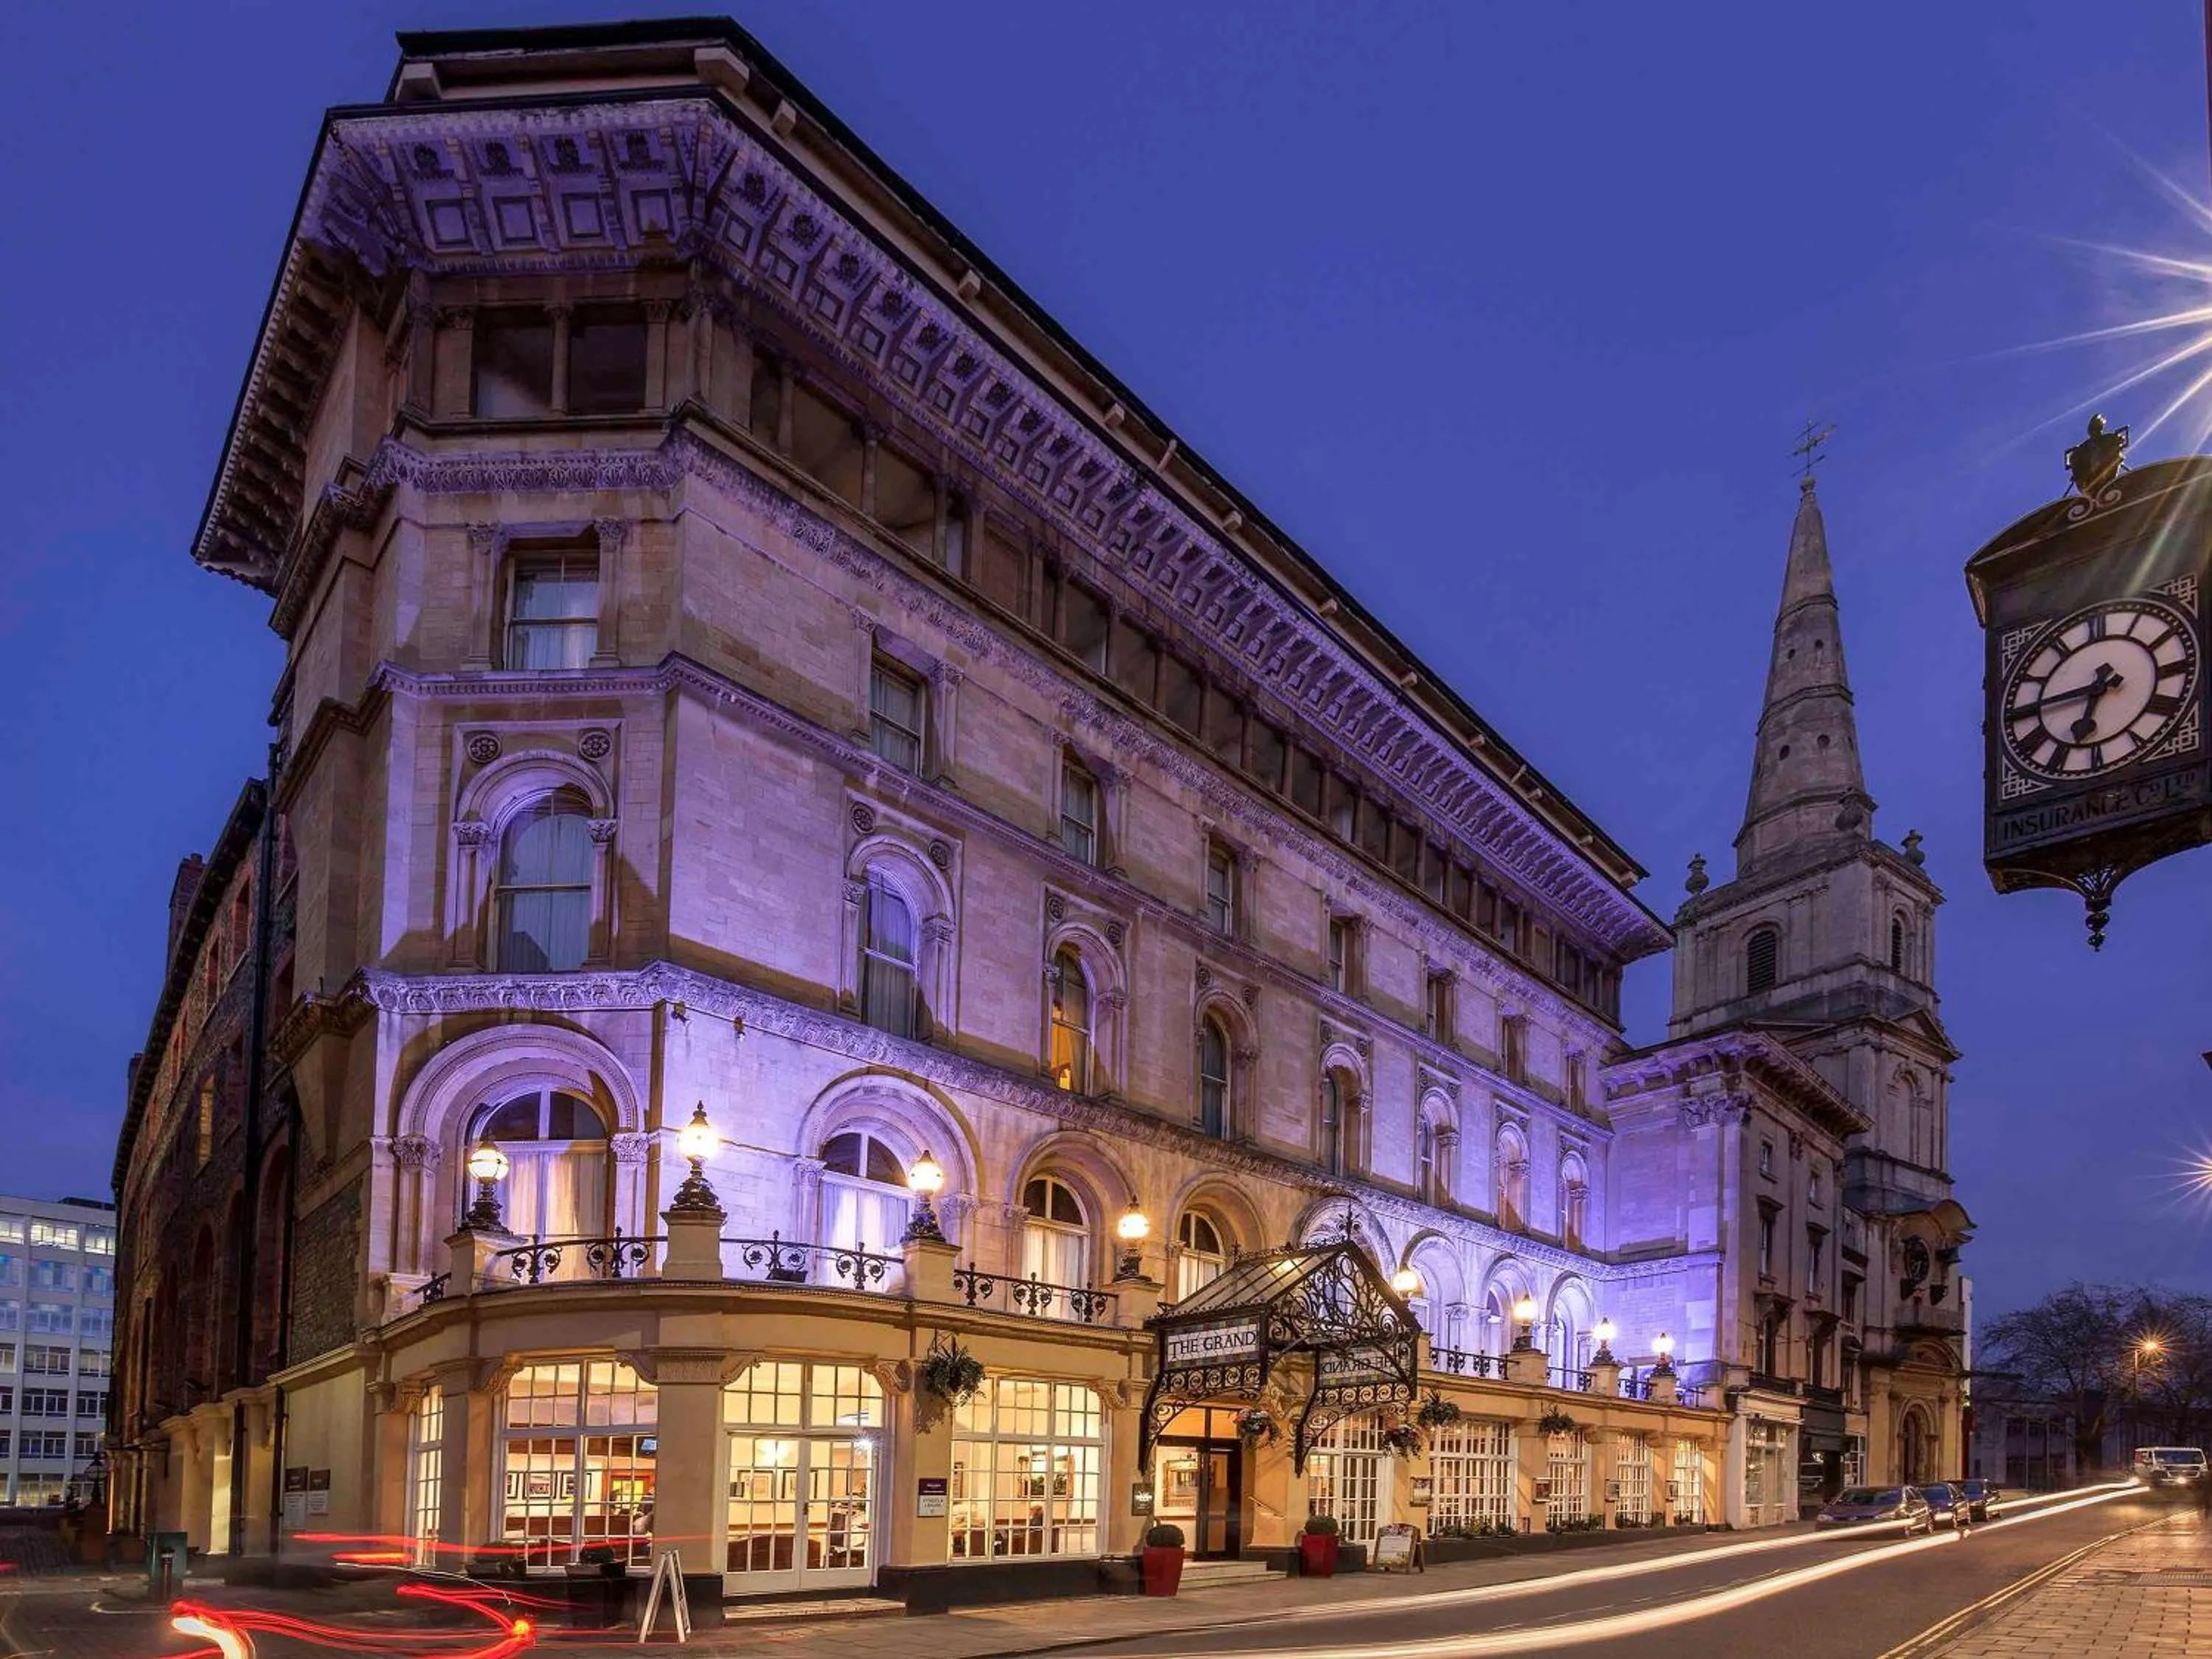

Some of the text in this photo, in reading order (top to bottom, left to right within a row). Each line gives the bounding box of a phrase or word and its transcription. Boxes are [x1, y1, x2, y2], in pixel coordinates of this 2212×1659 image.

[2004, 796, 2129, 840] INSURANCE
[1169, 1330, 1256, 1359] THE GRAND
